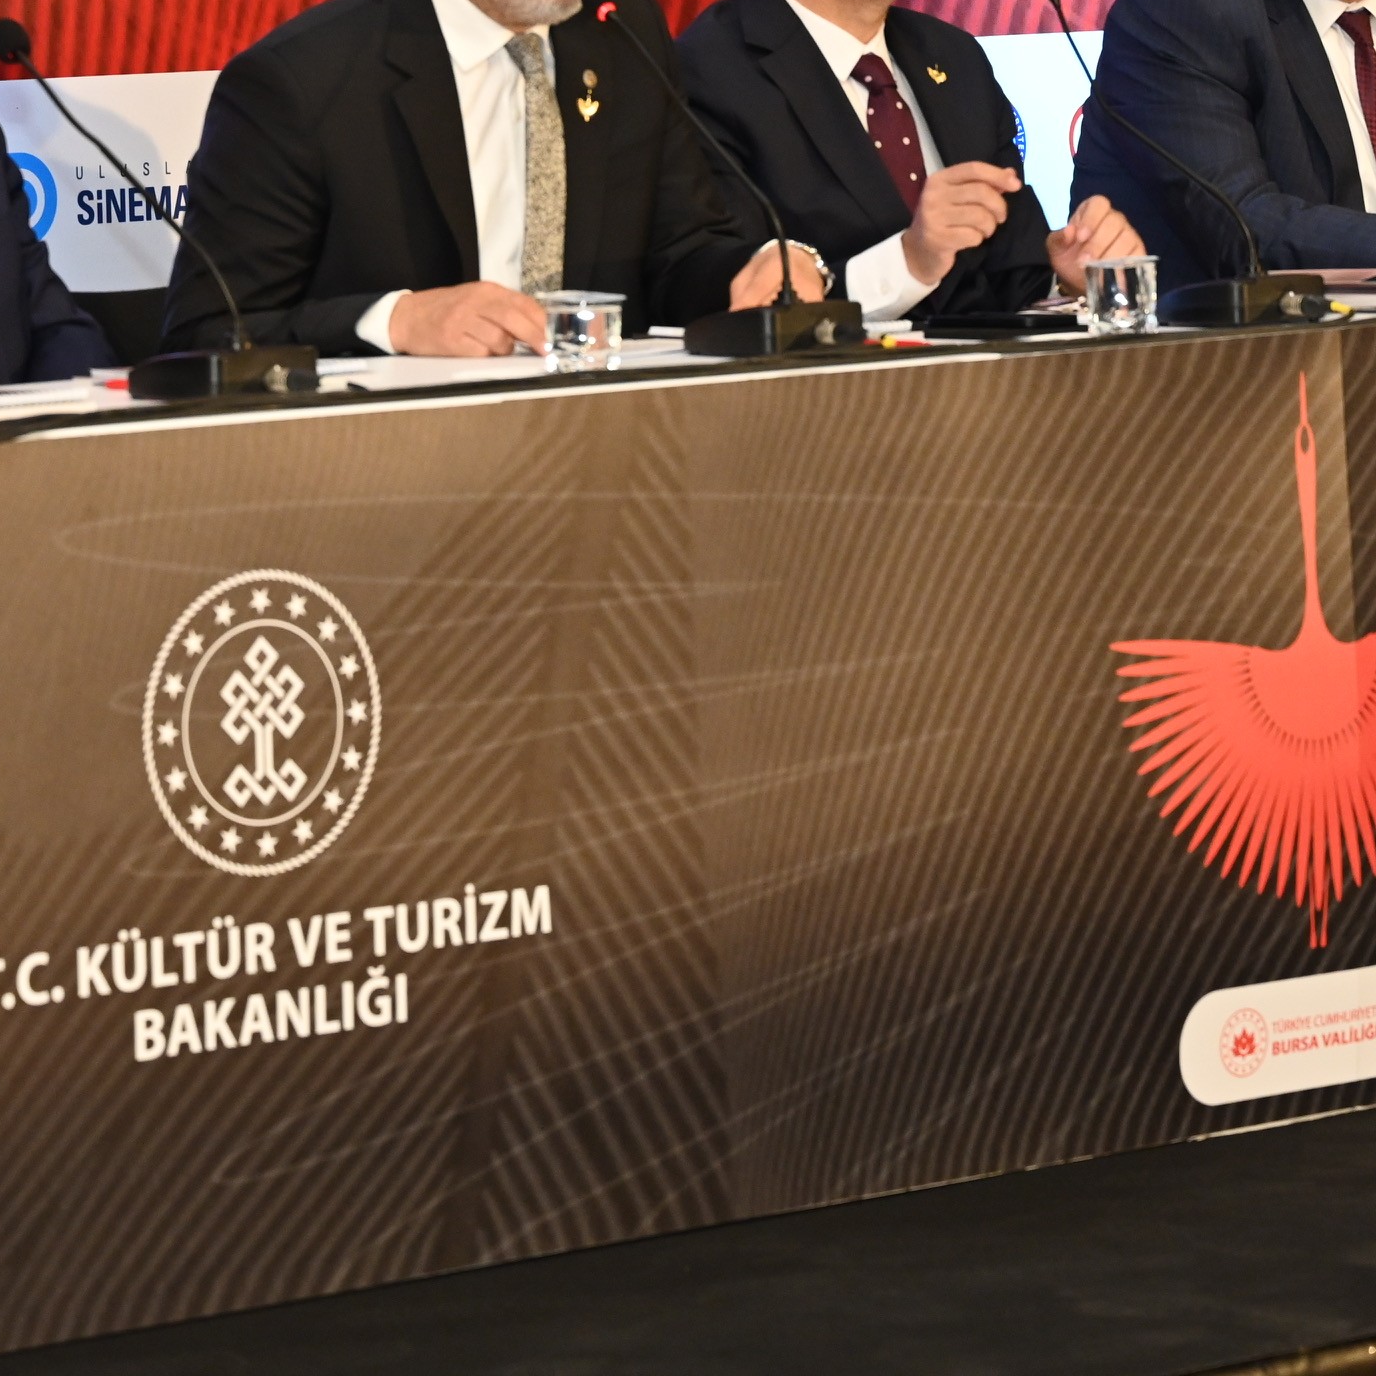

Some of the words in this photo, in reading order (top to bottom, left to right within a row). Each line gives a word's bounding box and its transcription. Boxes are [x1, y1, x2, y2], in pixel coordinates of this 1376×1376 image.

[76, 915, 276, 999] KÜLTÜR
[287, 911, 352, 966] VE
[364, 883, 552, 957] TURİZM
[133, 965, 410, 1062] BAKANLIĞI
[1272, 1035, 1319, 1056] BURSA
